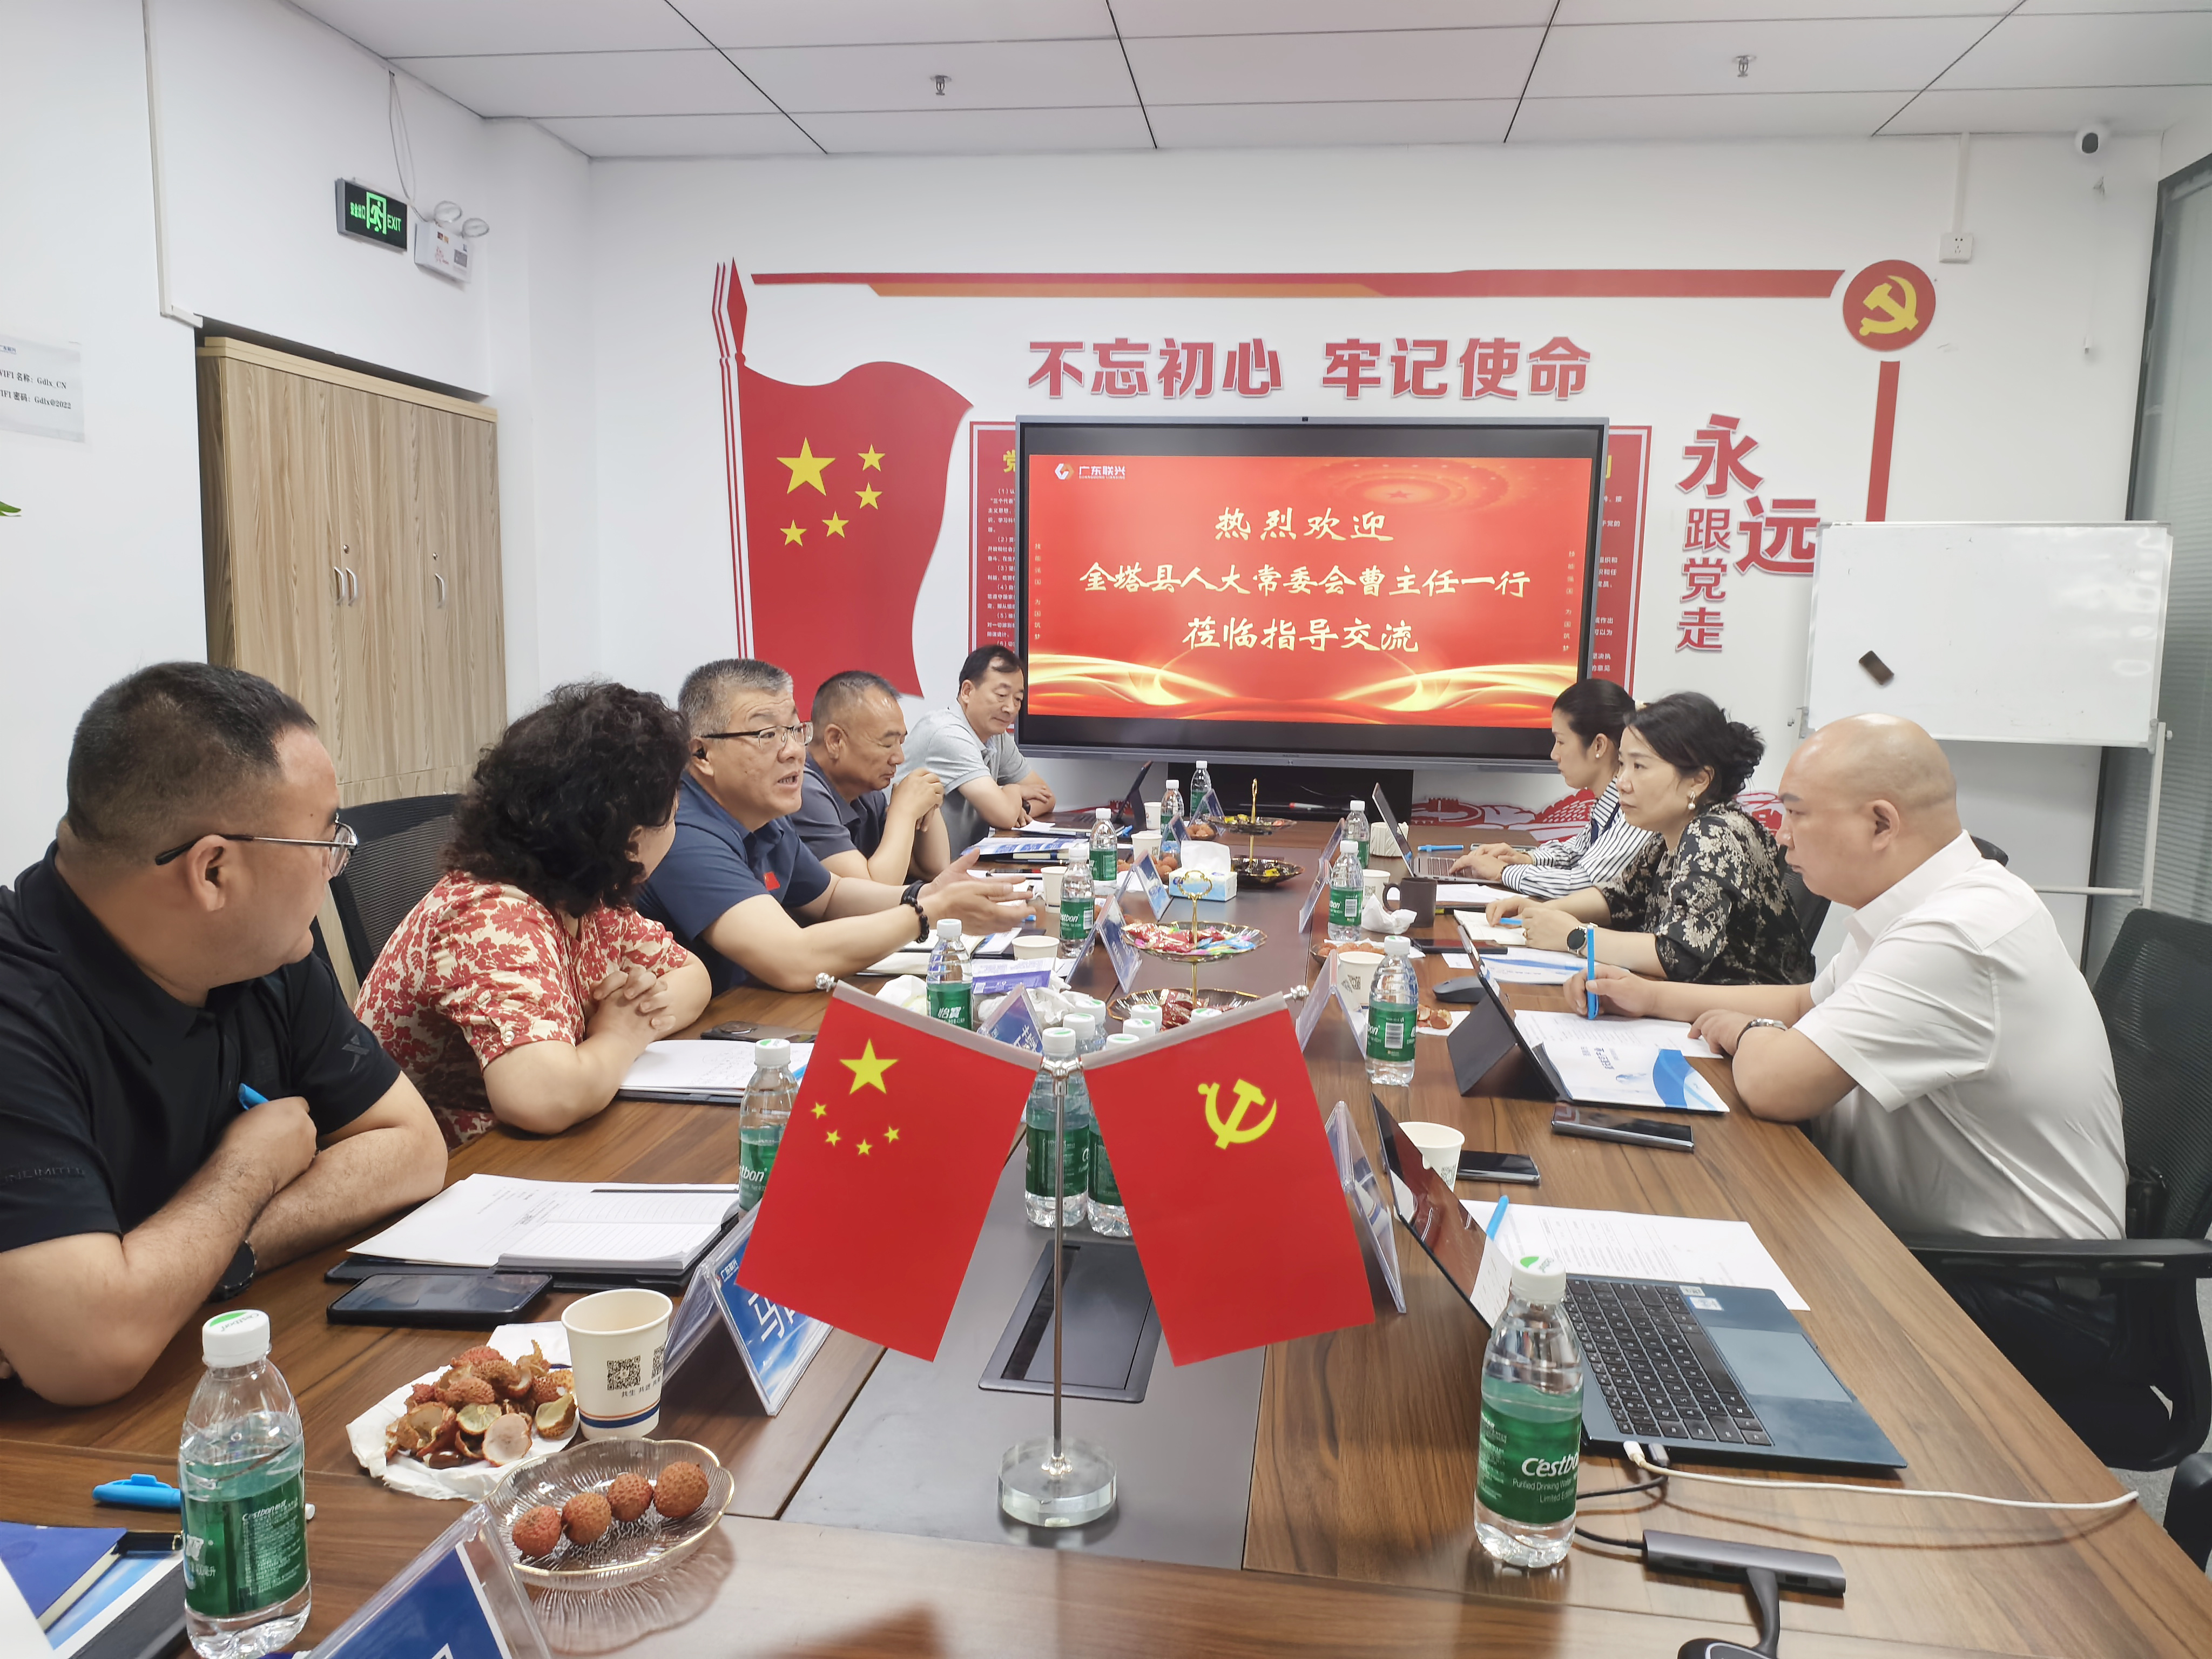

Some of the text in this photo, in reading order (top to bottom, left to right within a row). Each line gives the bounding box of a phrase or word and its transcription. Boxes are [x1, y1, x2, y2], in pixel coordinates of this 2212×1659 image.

[387, 214, 401, 232] EXIT
[1028, 336, 1591, 400] 不忘初心 牢记使命
[0, 389, 11, 398] IFI
[1079, 466, 1125, 476] 广东联兴
[1215, 507, 1394, 542] 热烈欢迎
[1080, 562, 1530, 598] 金塔县人大常委会曹主任一行
[1675, 508, 1730, 652] 跟党走
[1182, 616, 1419, 652] 莅临指导交流
[740, 1165, 765, 1182] tbon
